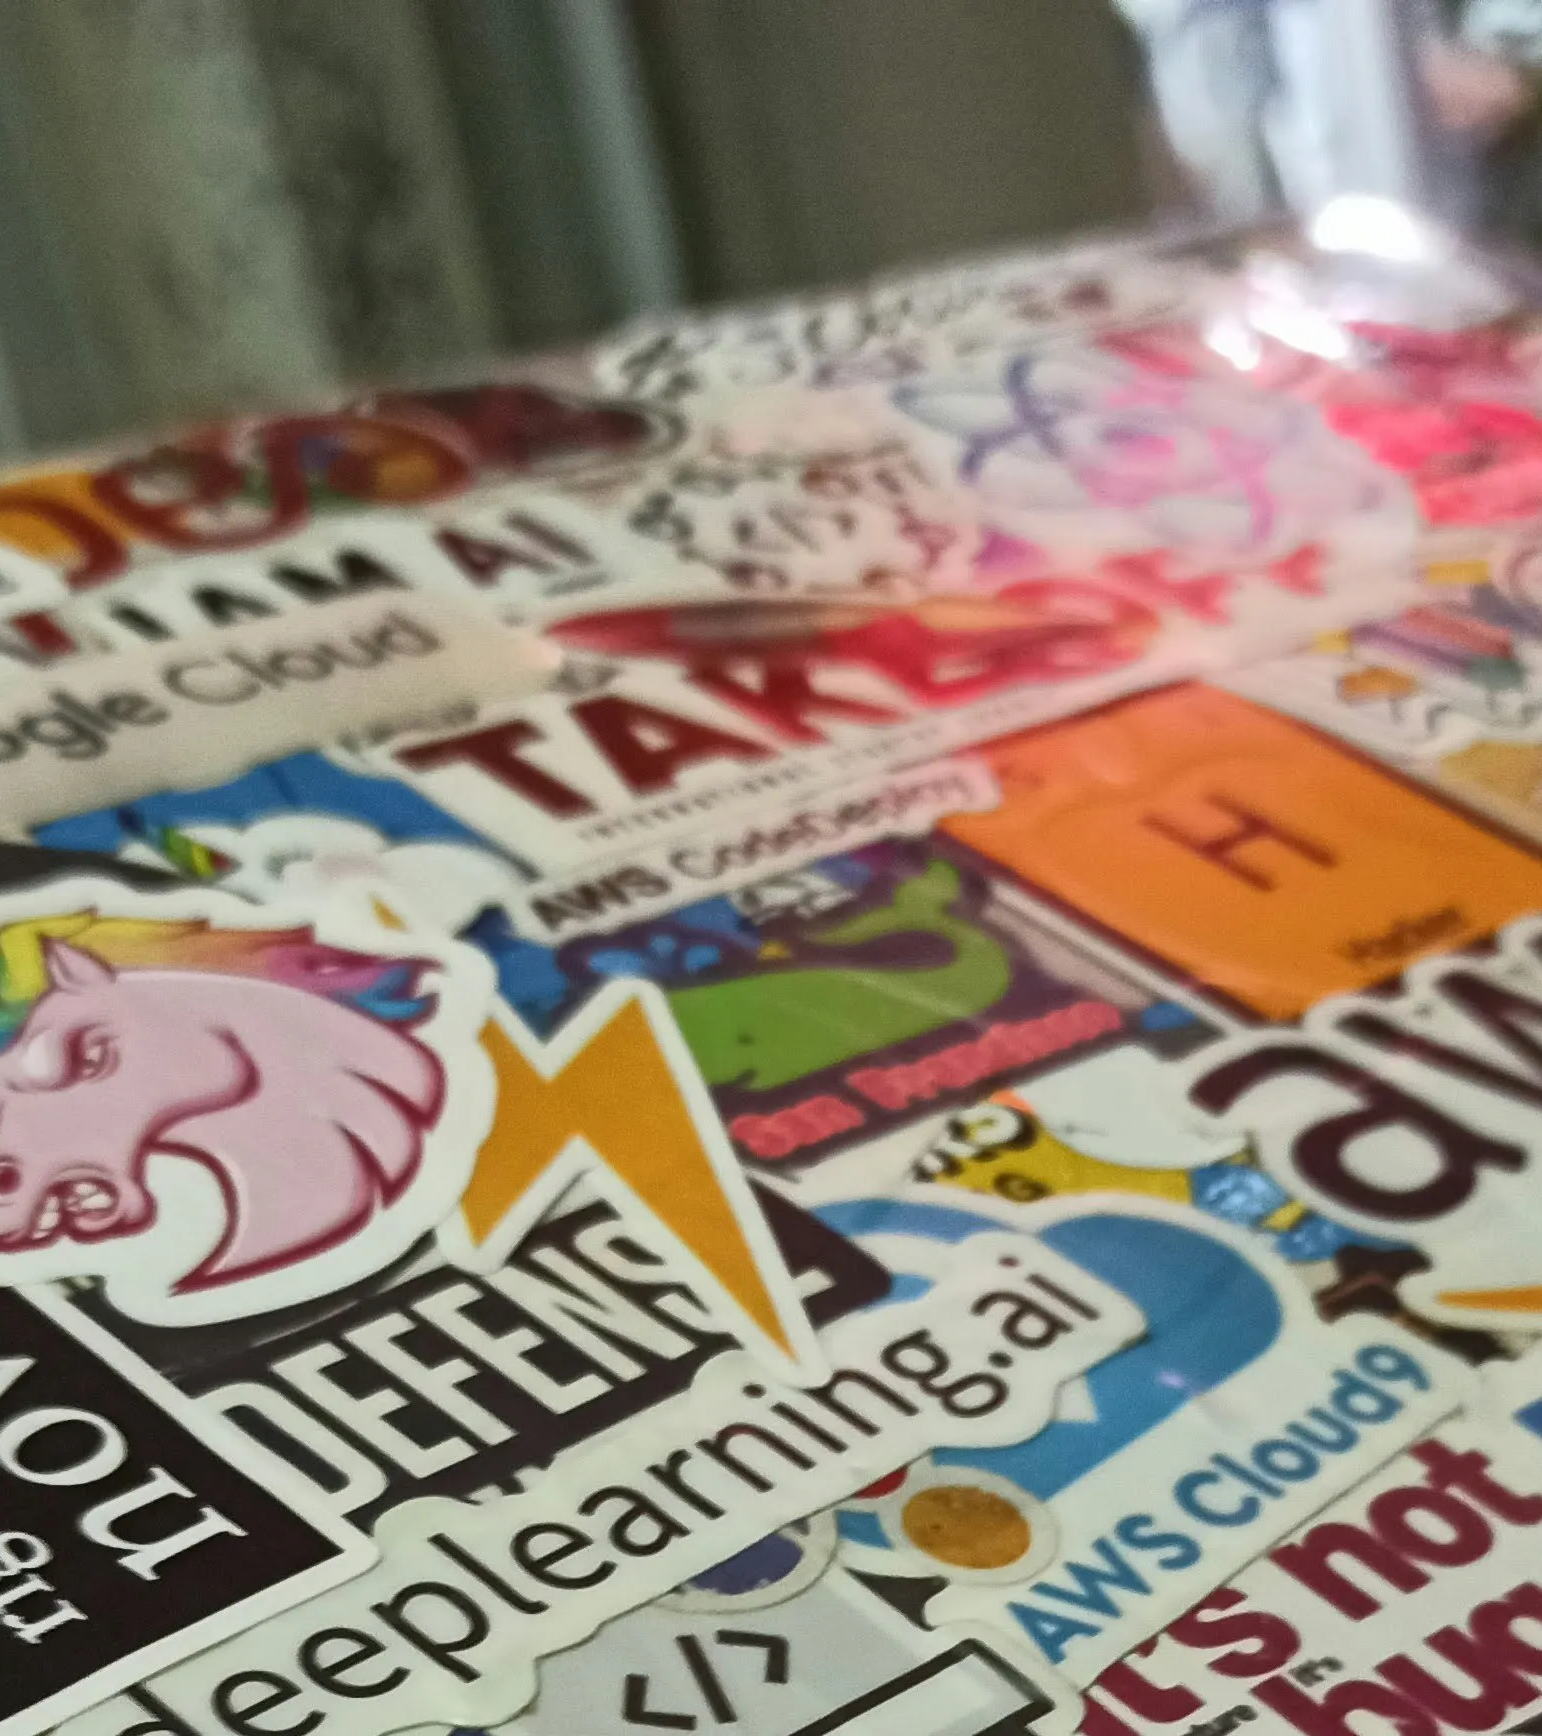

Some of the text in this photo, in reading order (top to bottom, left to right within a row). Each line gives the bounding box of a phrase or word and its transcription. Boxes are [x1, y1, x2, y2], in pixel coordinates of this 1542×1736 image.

[164, 610, 444, 706] Cloud
[1140, 796, 1339, 893] H
[533, 865, 672, 932] AWS
[216, 1215, 835, 1517] DEFENS
[1006, 1343, 1434, 1665] AWS Cloud9
